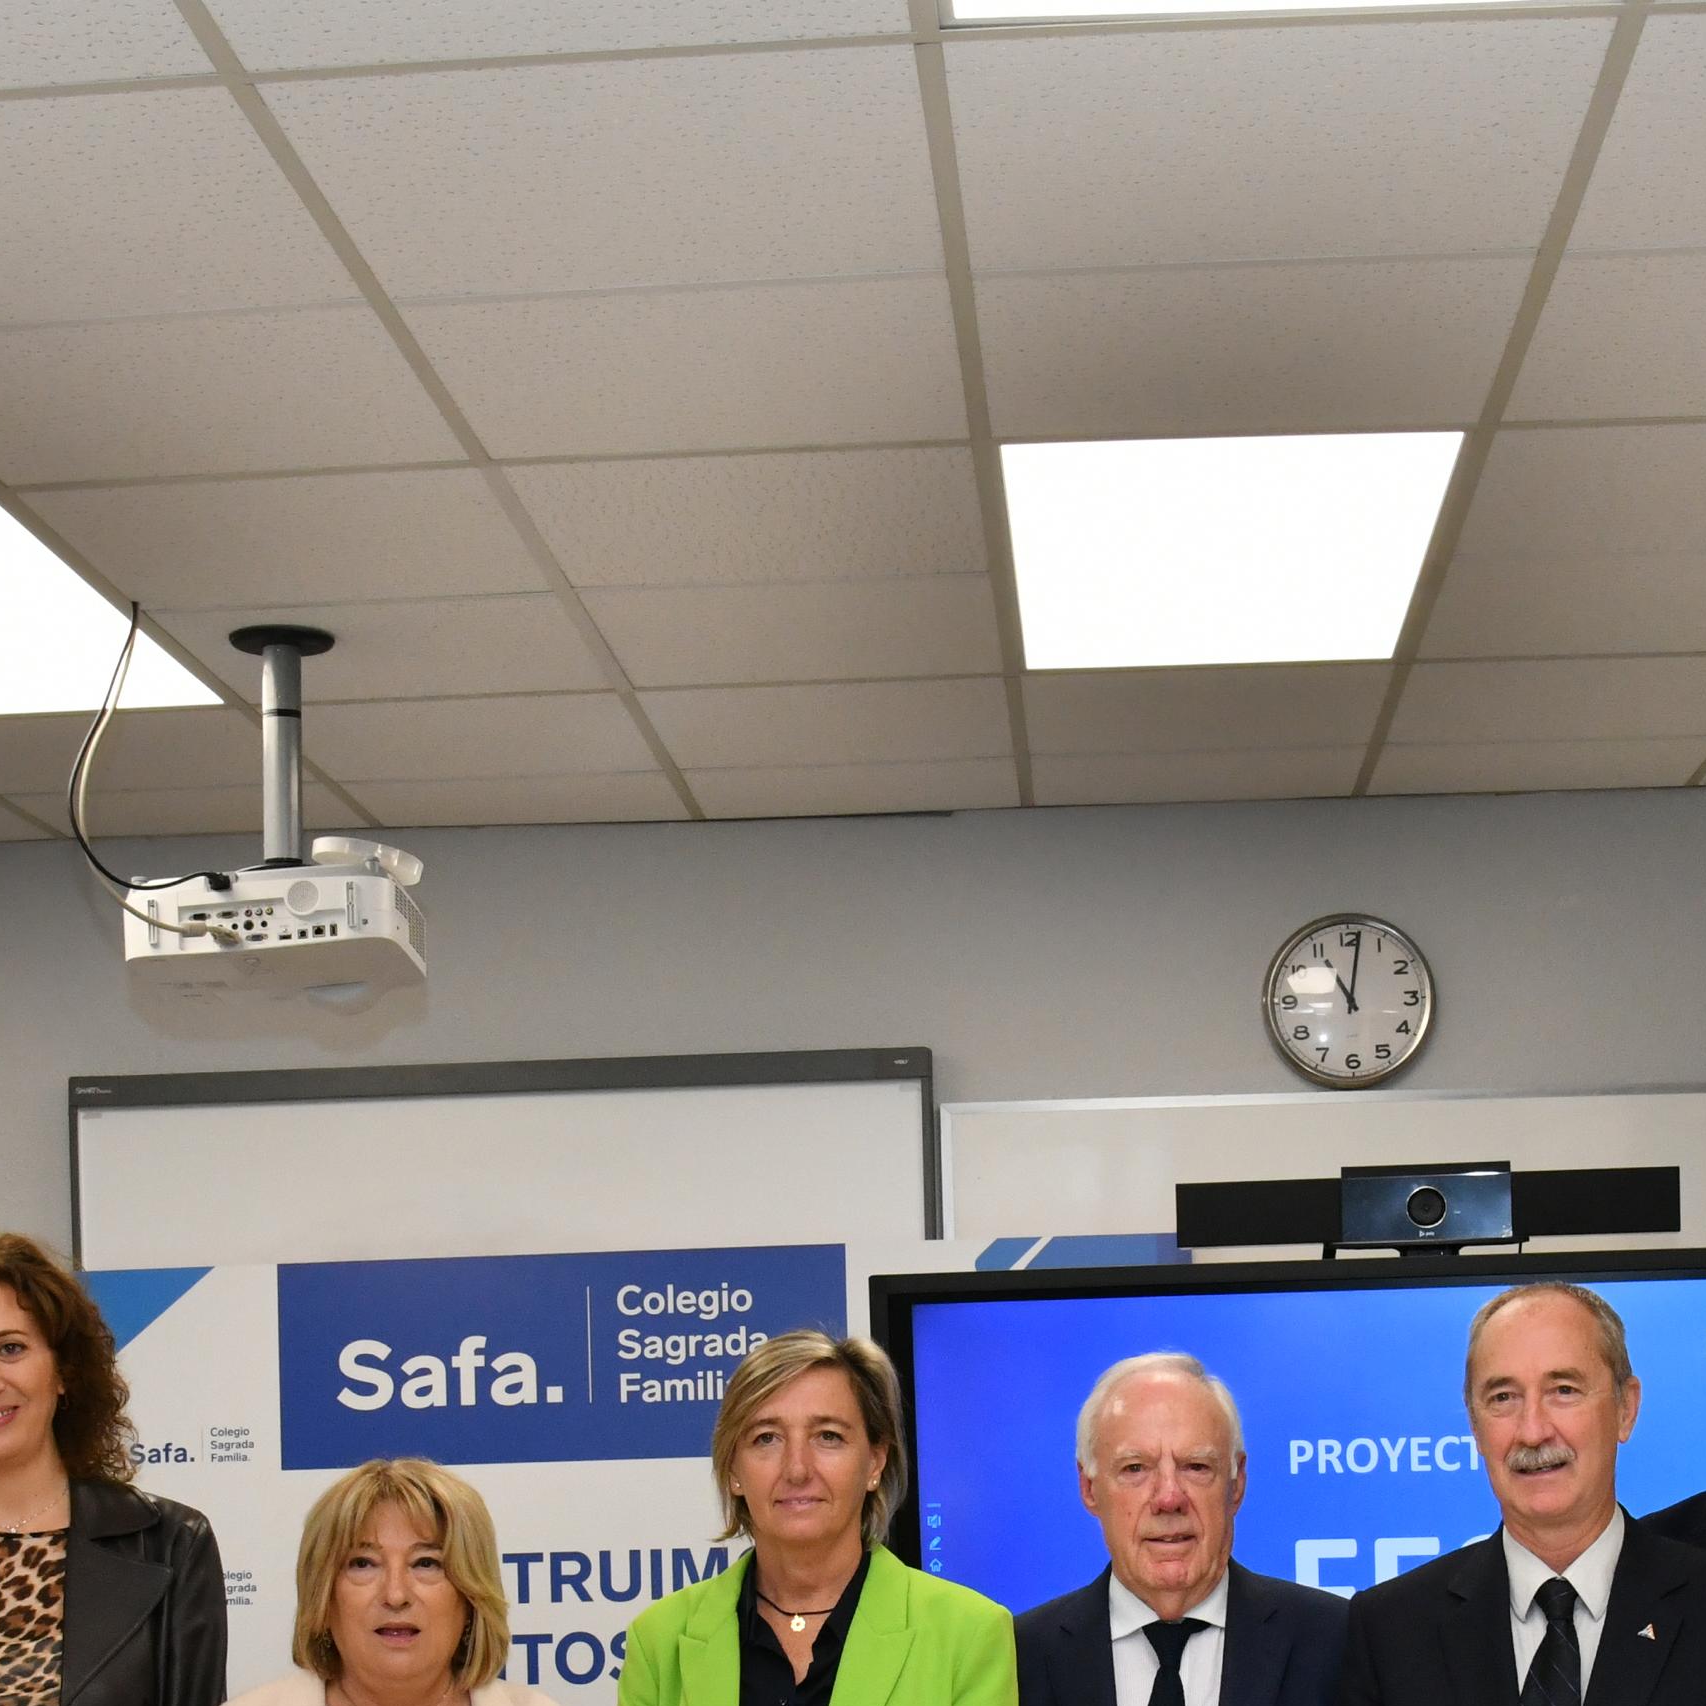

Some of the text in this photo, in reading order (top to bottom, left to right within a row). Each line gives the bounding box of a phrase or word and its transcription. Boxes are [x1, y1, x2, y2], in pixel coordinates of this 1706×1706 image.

[1339, 932, 1359, 947] 12
[1376, 938, 1382, 953] 1
[1313, 943, 1324, 958] 11
[1393, 960, 1409, 975] 2
[1281, 995, 1298, 1010] 9
[1403, 990, 1419, 1006] 3
[1293, 1025, 1310, 1040] 8
[1395, 1020, 1411, 1035] 4
[1315, 1047, 1330, 1062] 7
[1375, 1044, 1391, 1059] 5
[1345, 1054, 1361, 1069] 6
[616, 1282, 753, 1321] Colegio
[617, 1326, 770, 1365] Sagrada
[336, 1335, 564, 1411] Safa.
[619, 1370, 731, 1404] Famili
[210, 1427, 250, 1438] Colegio
[210, 1440, 255, 1451] Sagrada
[130, 1442, 195, 1465] Safa.
[1290, 1435, 1479, 1475] PROYECT
[223, 1571, 252, 1581] olegio
[227, 1584, 257, 1595] grada
